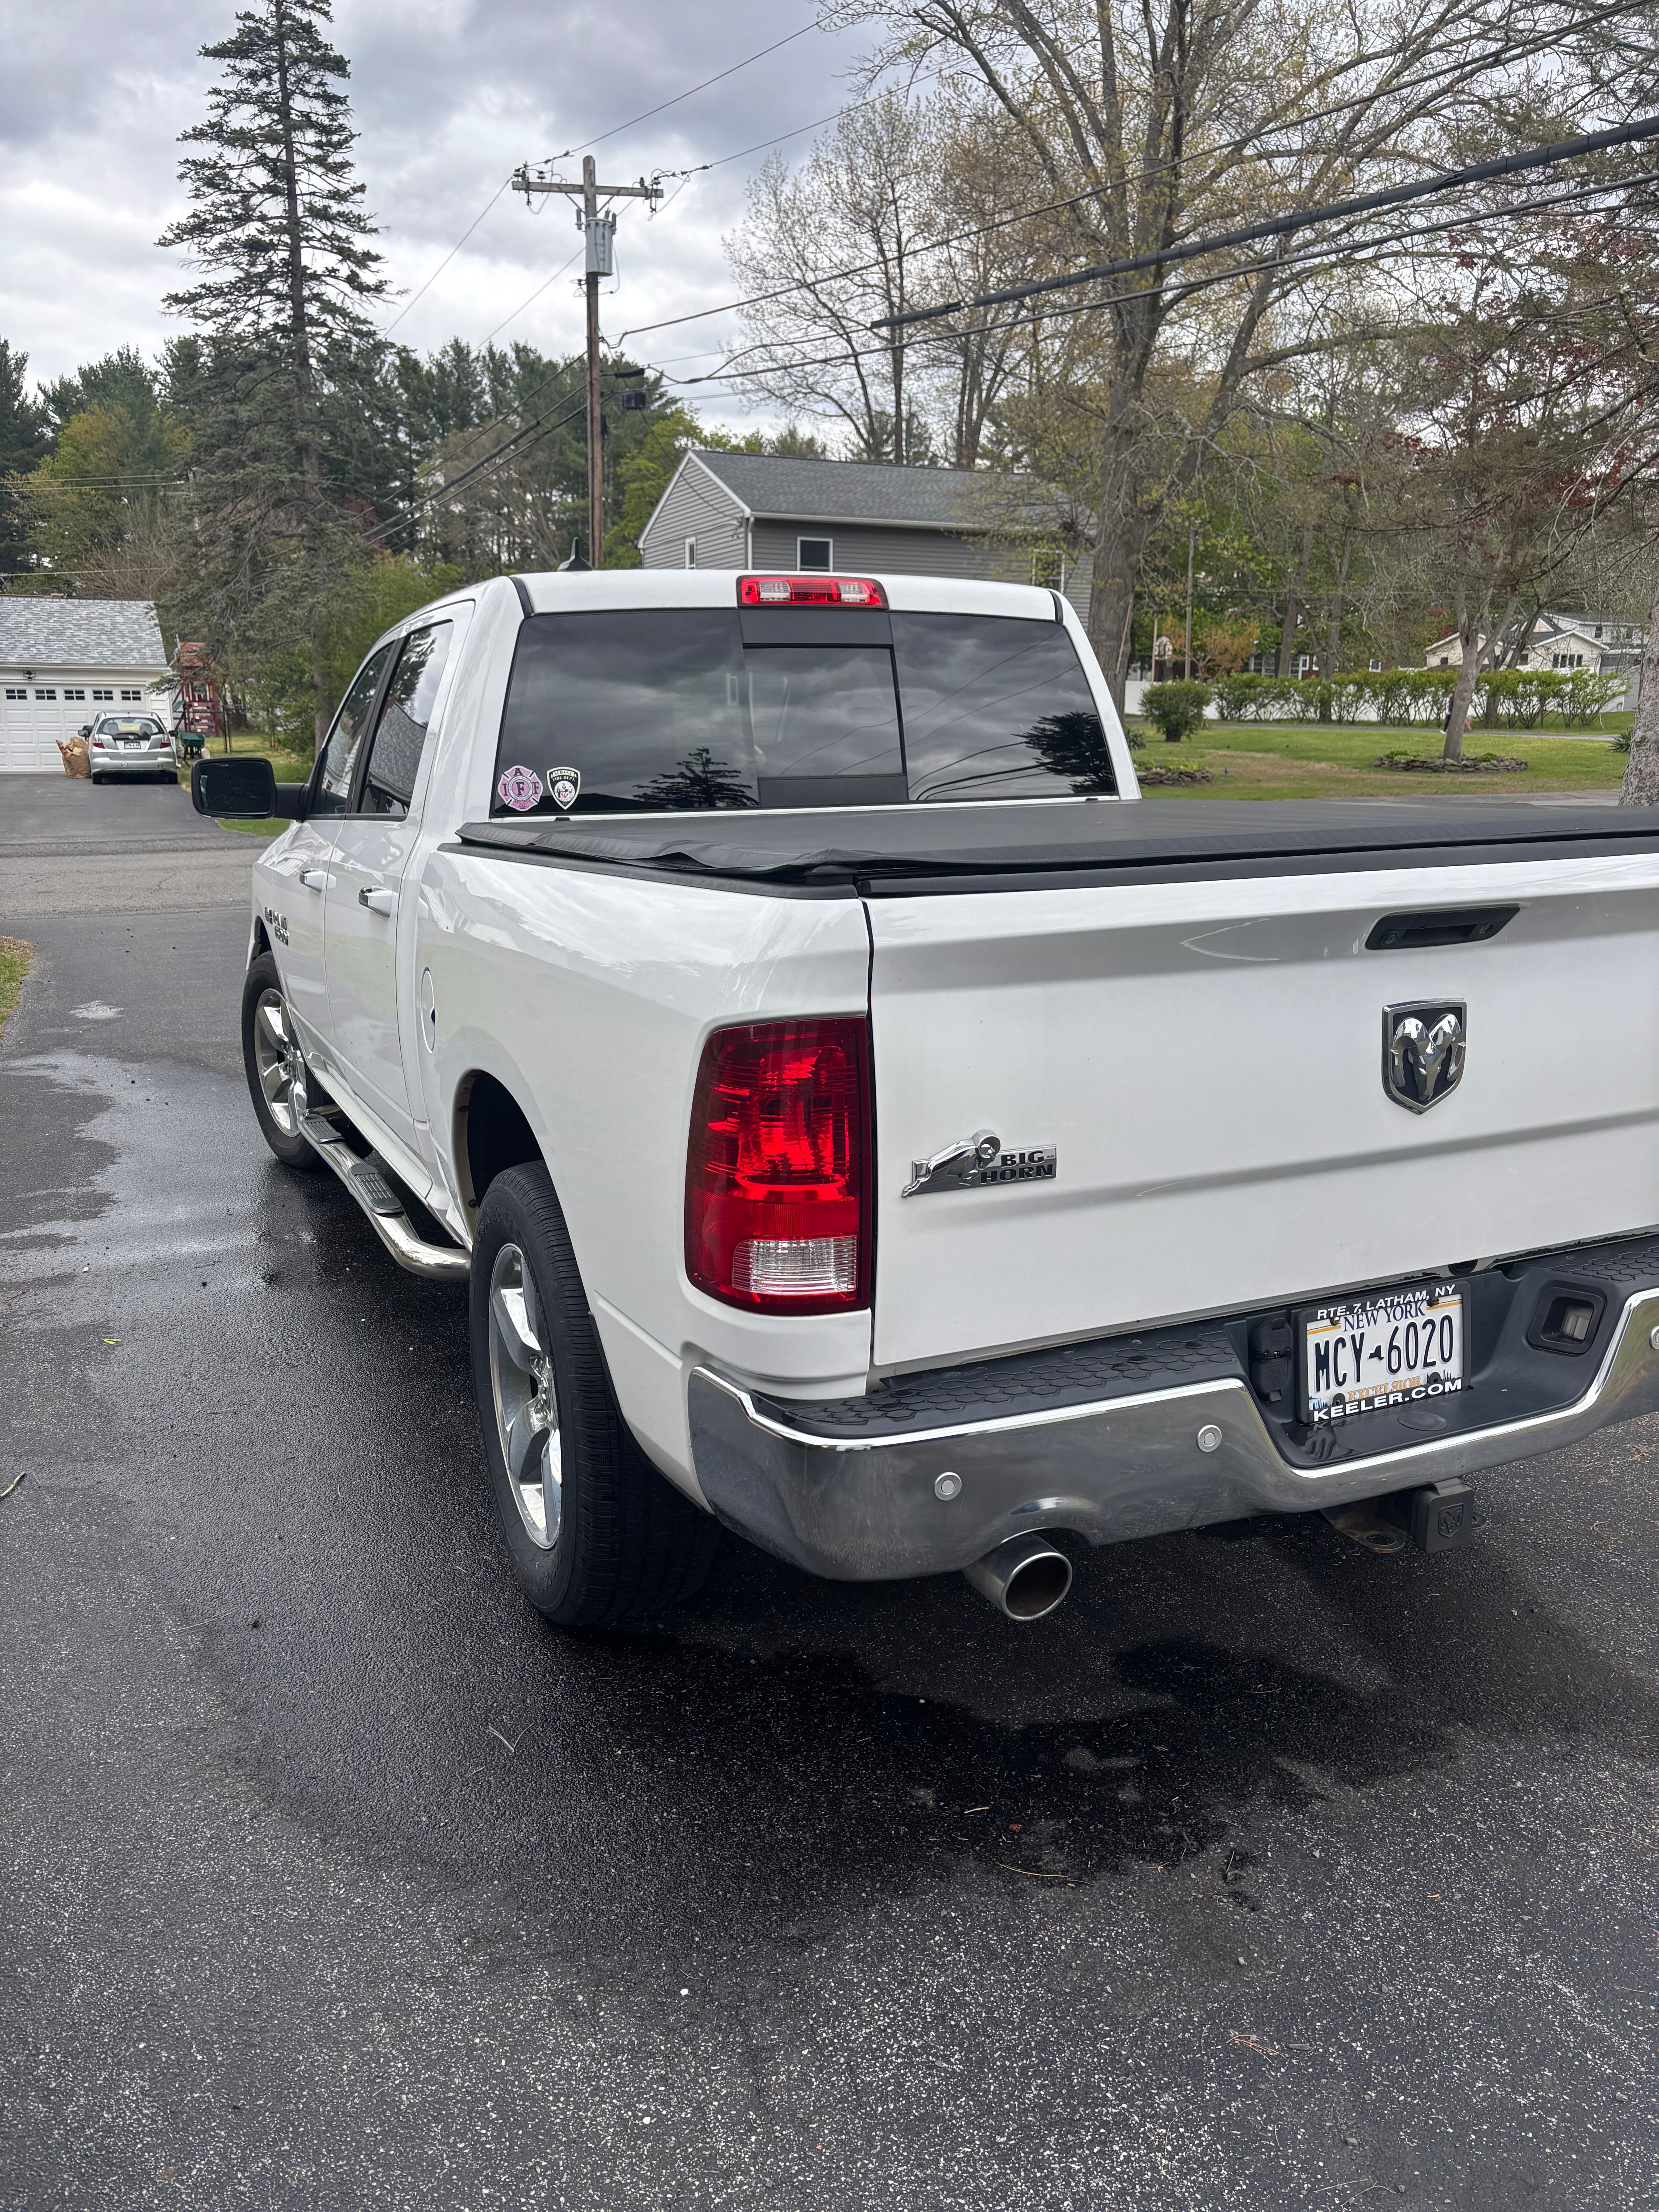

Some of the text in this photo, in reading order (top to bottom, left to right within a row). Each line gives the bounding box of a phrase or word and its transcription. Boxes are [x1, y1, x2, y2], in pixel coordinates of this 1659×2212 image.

[514, 768, 524, 776] A
[502, 783, 508, 796] I
[515, 781, 525, 796] F
[532, 781, 539, 795] F
[1001, 1151, 1044, 1168] BIG
[981, 1164, 1053, 1185] HORN
[1317, 1305, 1349, 1320] RTE.
[1366, 1290, 1429, 1311] LATHAM,
[1435, 1284, 1455, 1297] NY
[1343, 1300, 1426, 1332] NEW YORK
[1315, 1315, 1453, 1393] MCY 6020
[1314, 1379, 1462, 1422] KEELER.COM
[1348, 1376, 1422, 1401] EXCELSIOR
